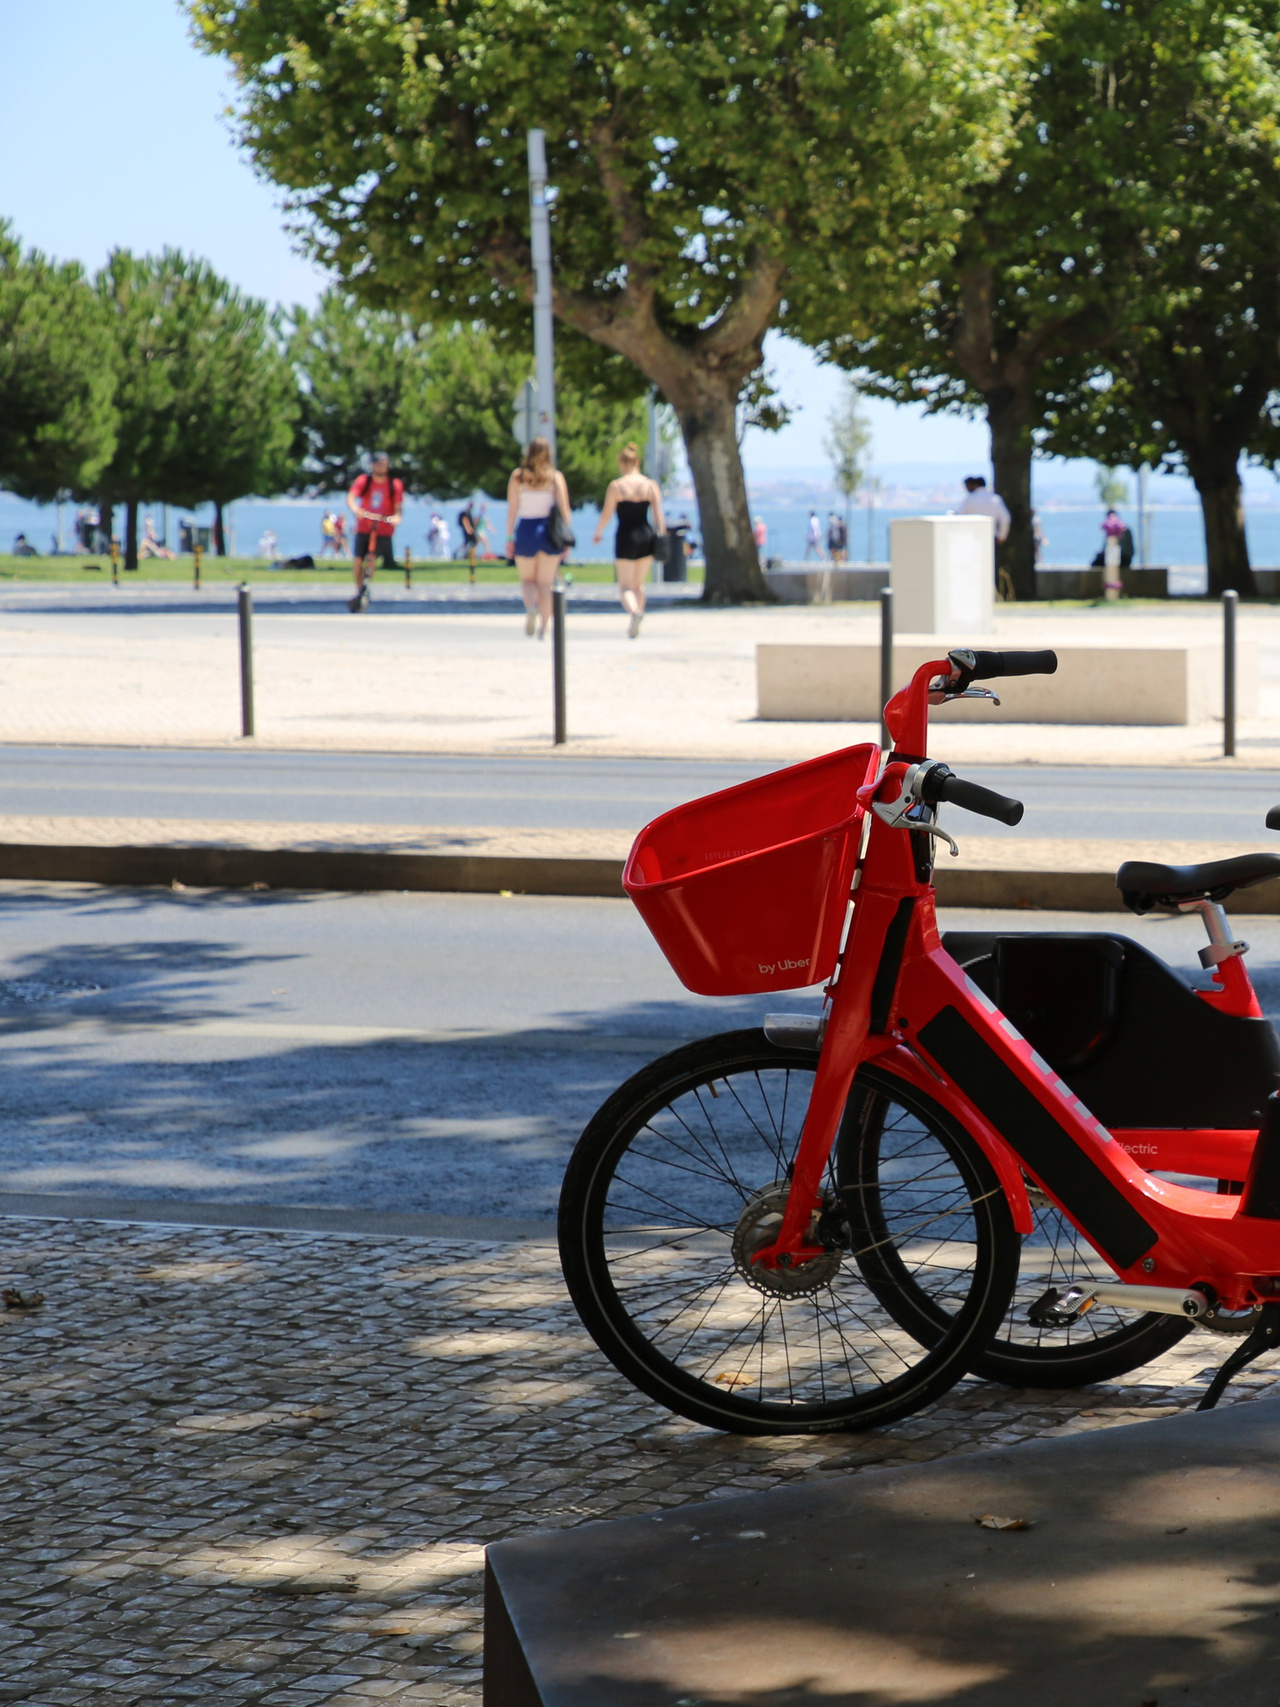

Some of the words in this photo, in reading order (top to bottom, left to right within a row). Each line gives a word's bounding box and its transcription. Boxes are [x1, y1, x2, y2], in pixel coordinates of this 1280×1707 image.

[758, 963, 776, 975] by
[777, 958, 811, 971] Uber
[1118, 1142, 1158, 1155] lectric
